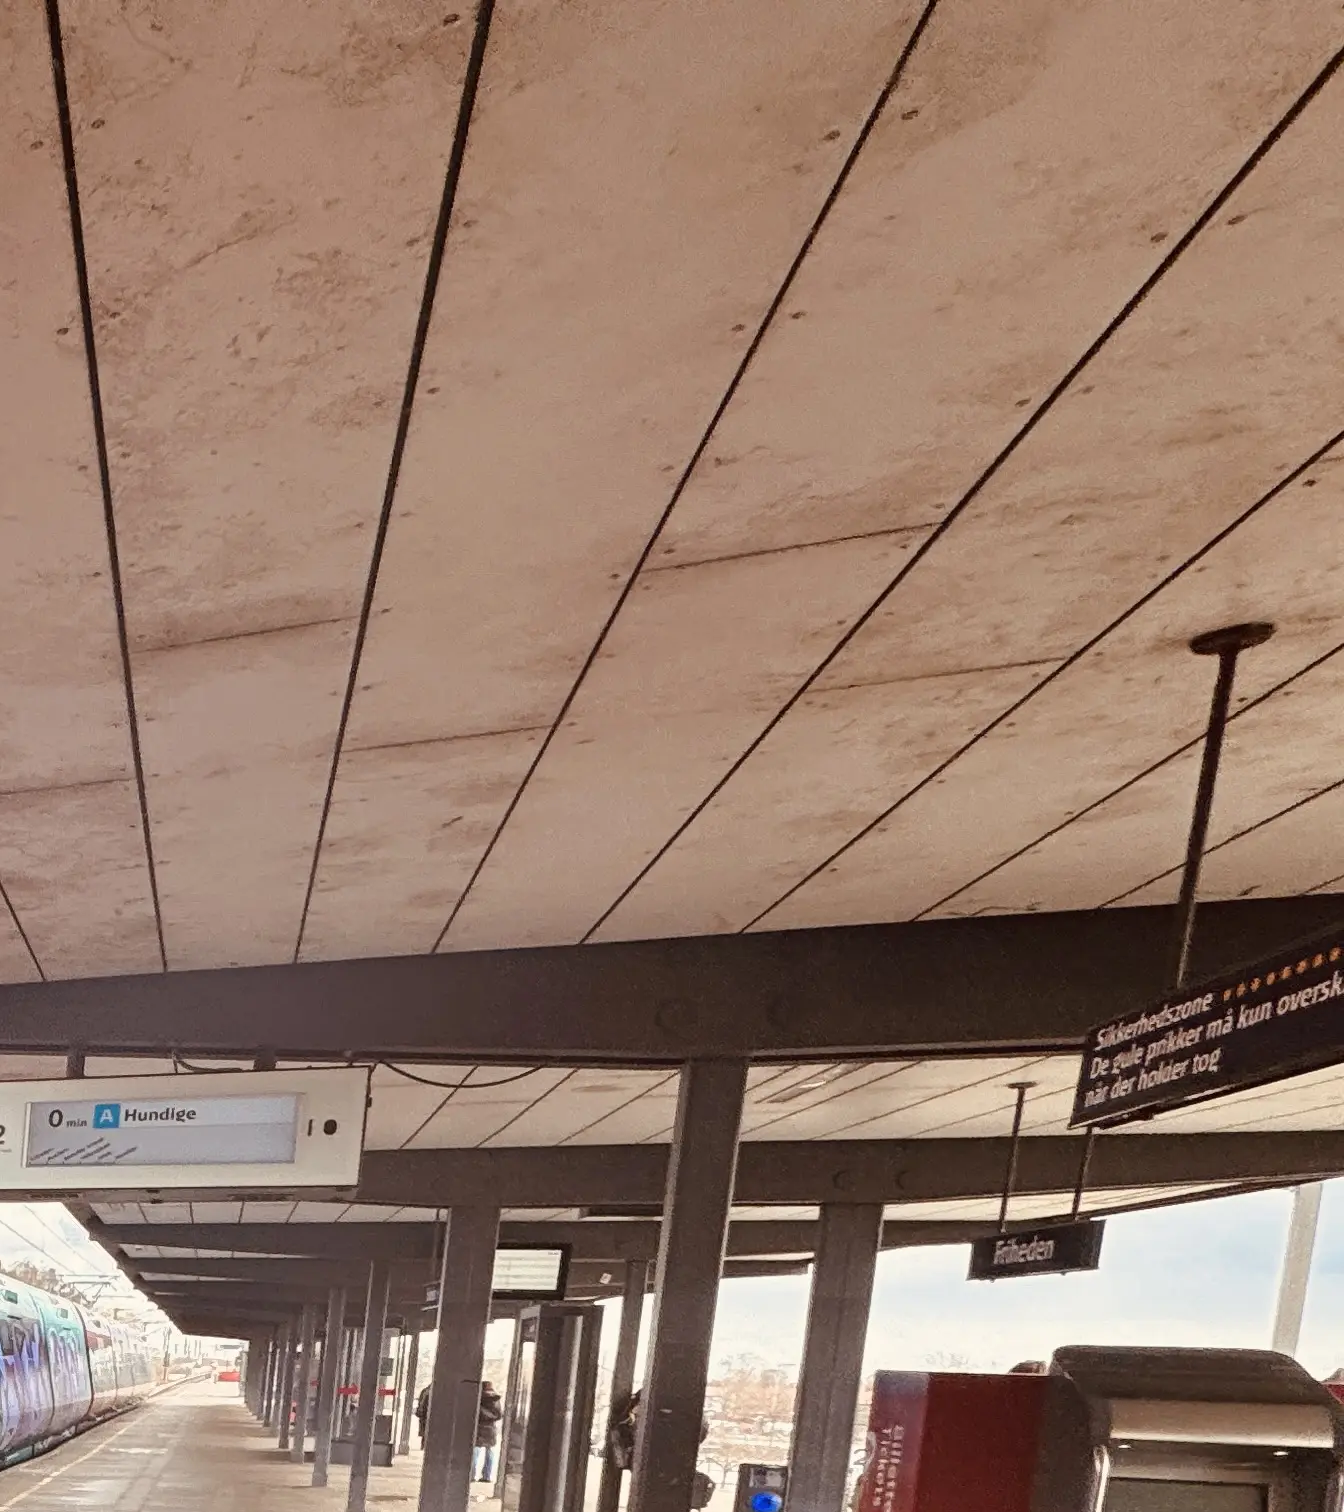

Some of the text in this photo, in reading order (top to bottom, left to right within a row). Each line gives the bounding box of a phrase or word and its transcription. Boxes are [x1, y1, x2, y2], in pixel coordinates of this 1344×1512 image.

[1090, 970, 1344, 1079] De gule prikker må kun oversk
[1085, 1047, 1223, 1107] når der holder tog
[66, 1119, 88, 1128] min
[124, 1107, 197, 1123] Hundige
